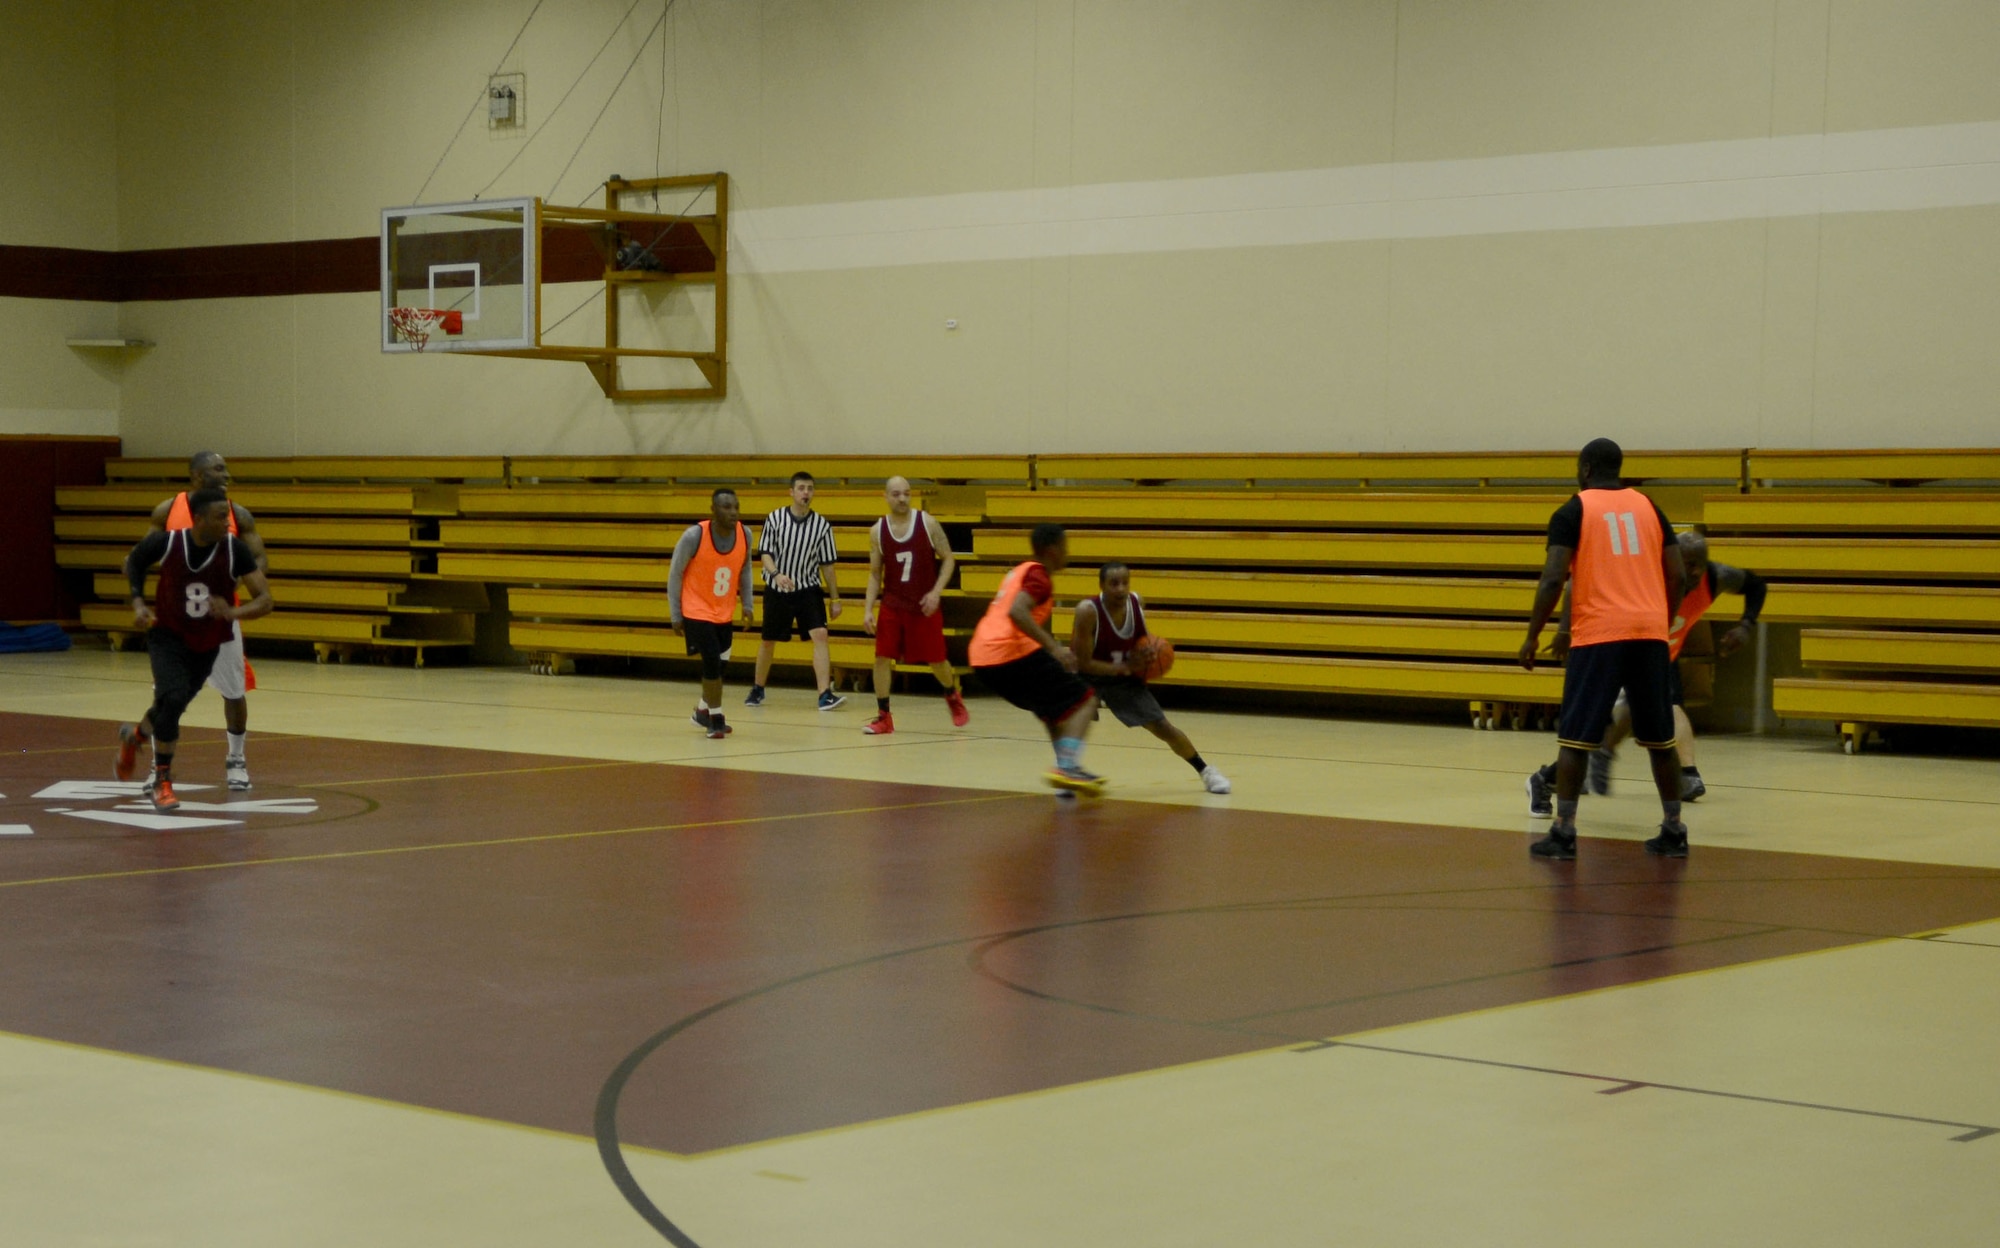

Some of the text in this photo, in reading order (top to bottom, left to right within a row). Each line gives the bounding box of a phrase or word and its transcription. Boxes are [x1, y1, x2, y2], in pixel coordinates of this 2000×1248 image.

[1603, 511, 1640, 555] 11
[713, 566, 731, 597] 8
[895, 551, 913, 582] 7
[185, 582, 209, 618] 8
